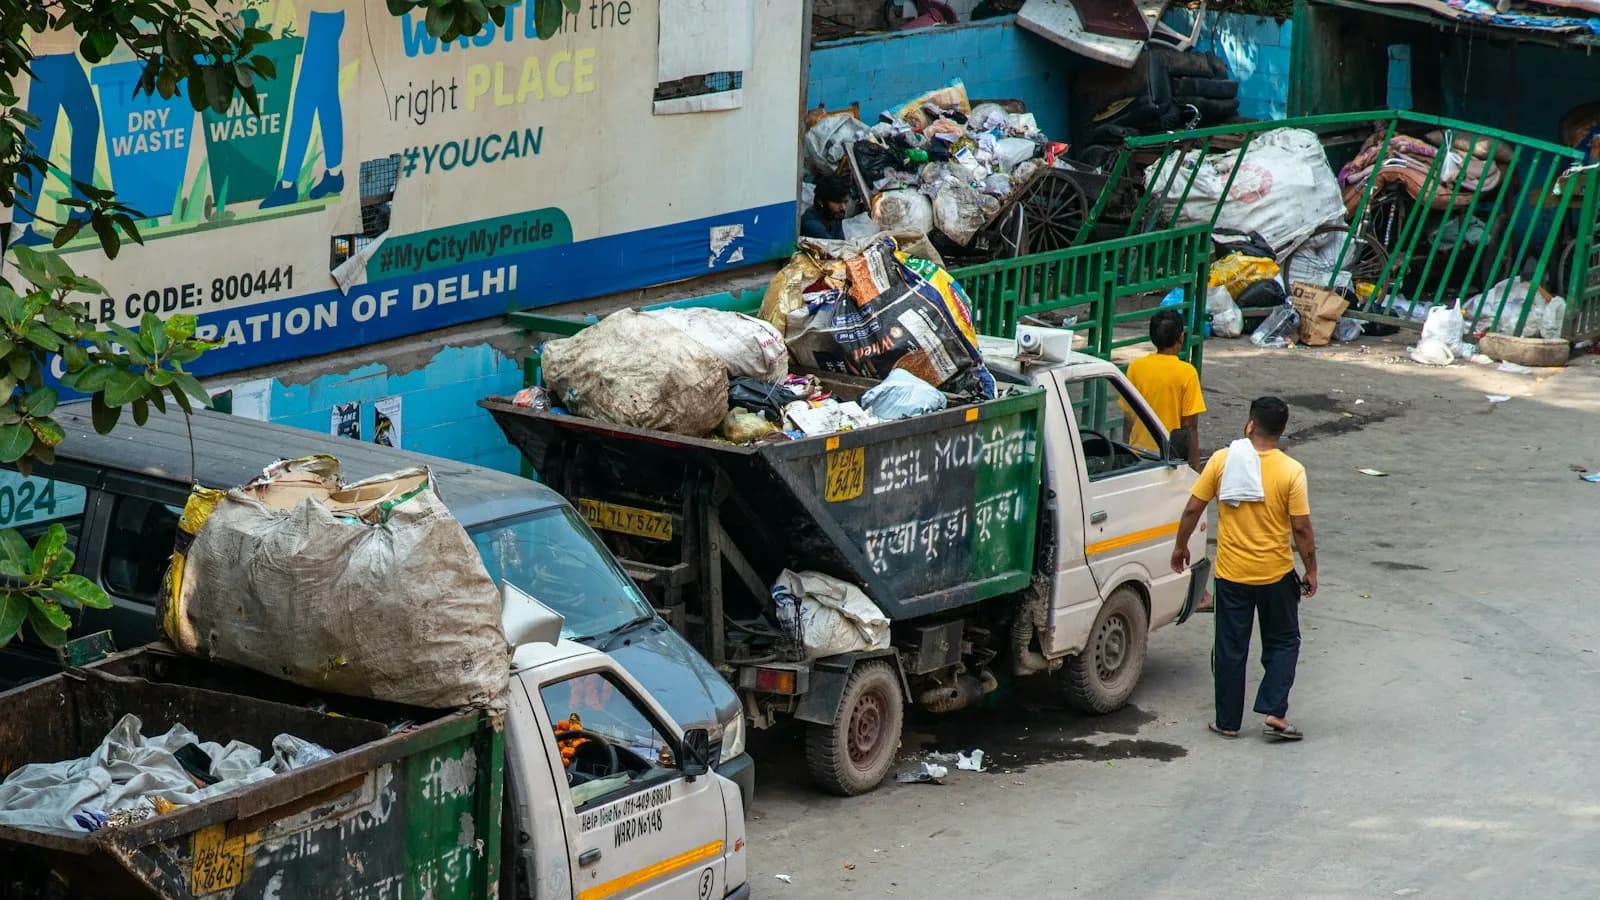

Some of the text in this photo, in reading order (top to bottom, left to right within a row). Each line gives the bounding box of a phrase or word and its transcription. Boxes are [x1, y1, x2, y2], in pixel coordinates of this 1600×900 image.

[589, 0, 632, 29] the
[395, 48, 596, 125] right PLACE
[128, 107, 170, 133] DRY
[225, 93, 268, 119] WT
[112, 127, 185, 157] WASTE
[210, 113, 281, 143] WASTE
[402, 126, 544, 178] #YOUCAN
[379, 218, 554, 272] #MyCityMyPride
[76, 265, 293, 330] LB CODE: 800441
[351, 289, 399, 323] OF
[412, 264, 517, 311] DELHI
[582, 811, 598, 832] Help
[614, 818, 636, 848] WARD
[701, 874, 710, 897] 3
